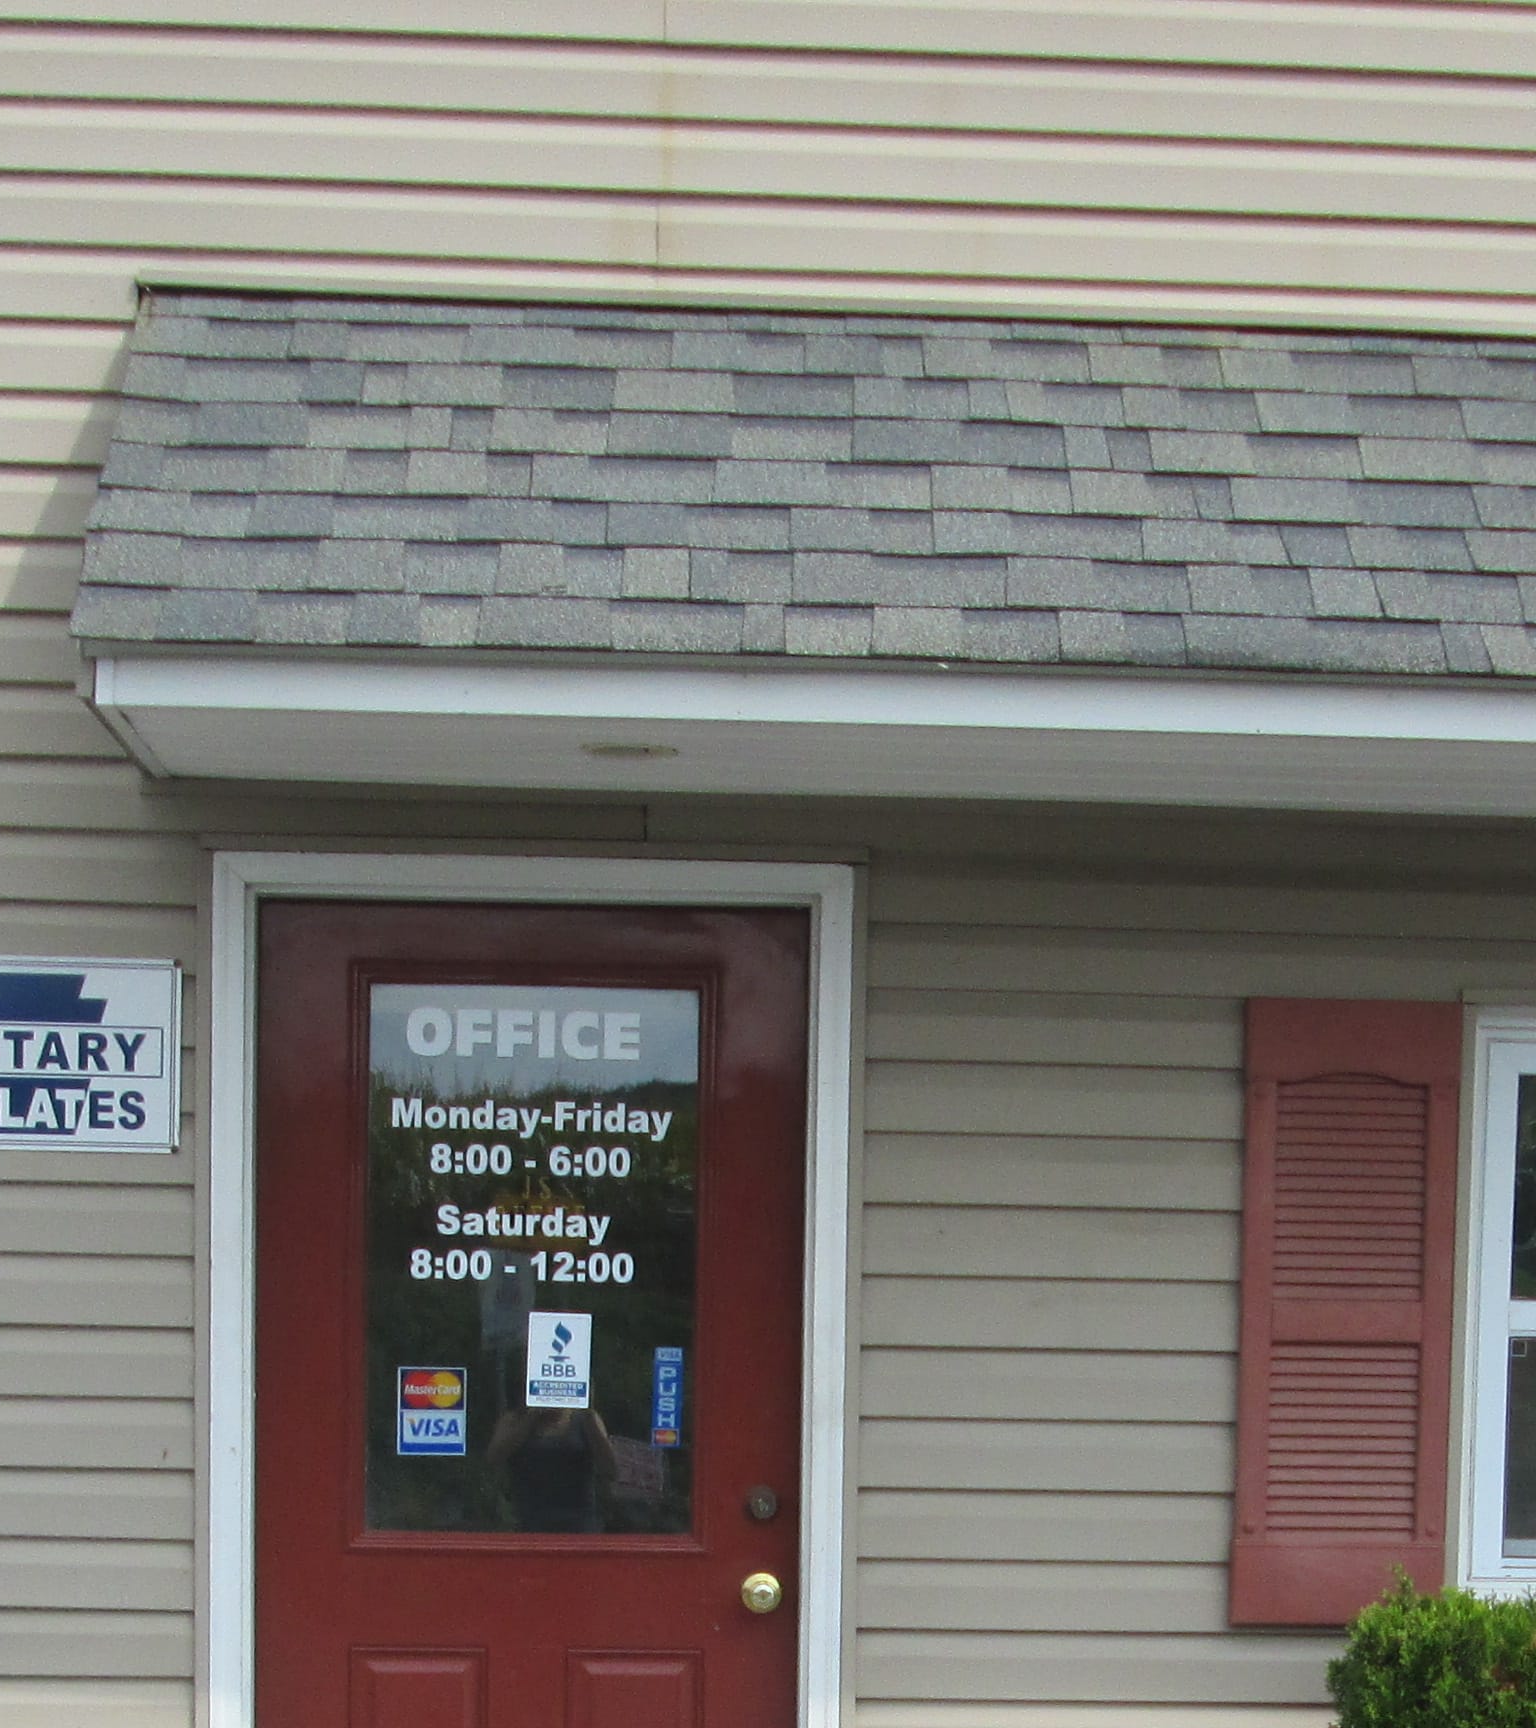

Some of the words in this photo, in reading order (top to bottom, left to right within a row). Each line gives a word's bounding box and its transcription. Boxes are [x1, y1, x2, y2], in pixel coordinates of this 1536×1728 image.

[406, 1007, 640, 1061] OFFICE
[391, 1098, 673, 1142] Monday-Friday
[430, 1143, 512, 1175] 8:00
[524, 1158, 537, 1168] -
[549, 1146, 631, 1178] 6:00
[436, 1204, 611, 1245] Saturday
[409, 1249, 492, 1280] 8:00
[504, 1265, 516, 1274] -
[530, 1251, 634, 1283] 12:00
[541, 1364, 576, 1377] BBB
[404, 1384, 462, 1395] MasterCard
[658, 1366, 677, 1428] PUSH
[408, 1417, 460, 1436] VISA
